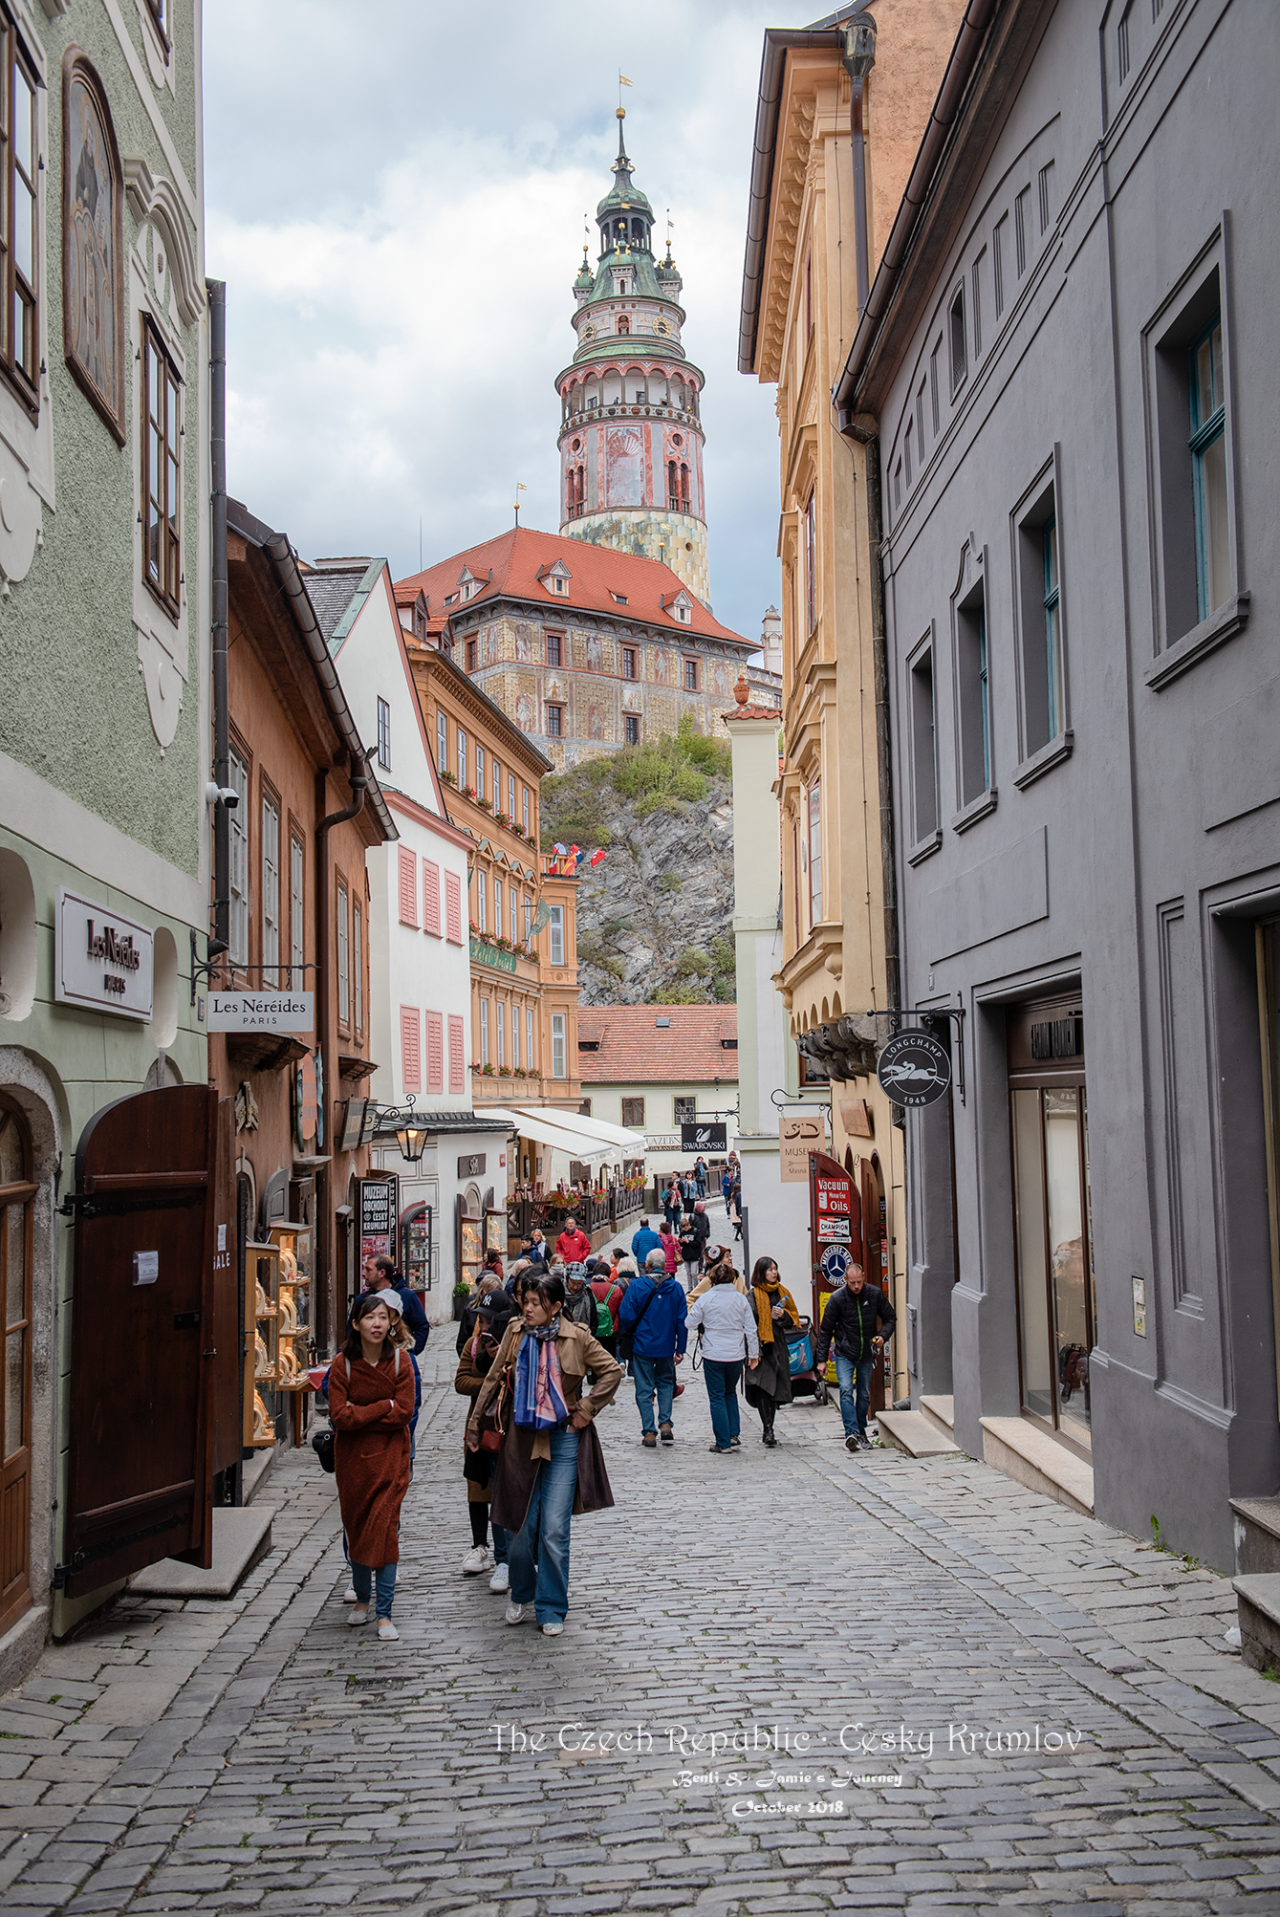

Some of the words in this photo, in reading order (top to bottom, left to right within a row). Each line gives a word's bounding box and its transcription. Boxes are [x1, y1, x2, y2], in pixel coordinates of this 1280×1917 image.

[104, 974, 126, 994] PARIS
[213, 999, 238, 1013] Les
[242, 998, 306, 1013] Néréides
[885, 1037, 942, 1059] LONGCHAMP
[903, 1096, 926, 1104] 1948
[683, 1142, 726, 1150] SWAROVSKI
[818, 1179, 848, 1191] Vacuum
[363, 1185, 388, 1200] MUZEUM
[830, 1200, 848, 1211] Oils
[372, 1212, 388, 1221] ČESKÝ
[363, 1221, 388, 1231] KRUMLOV
